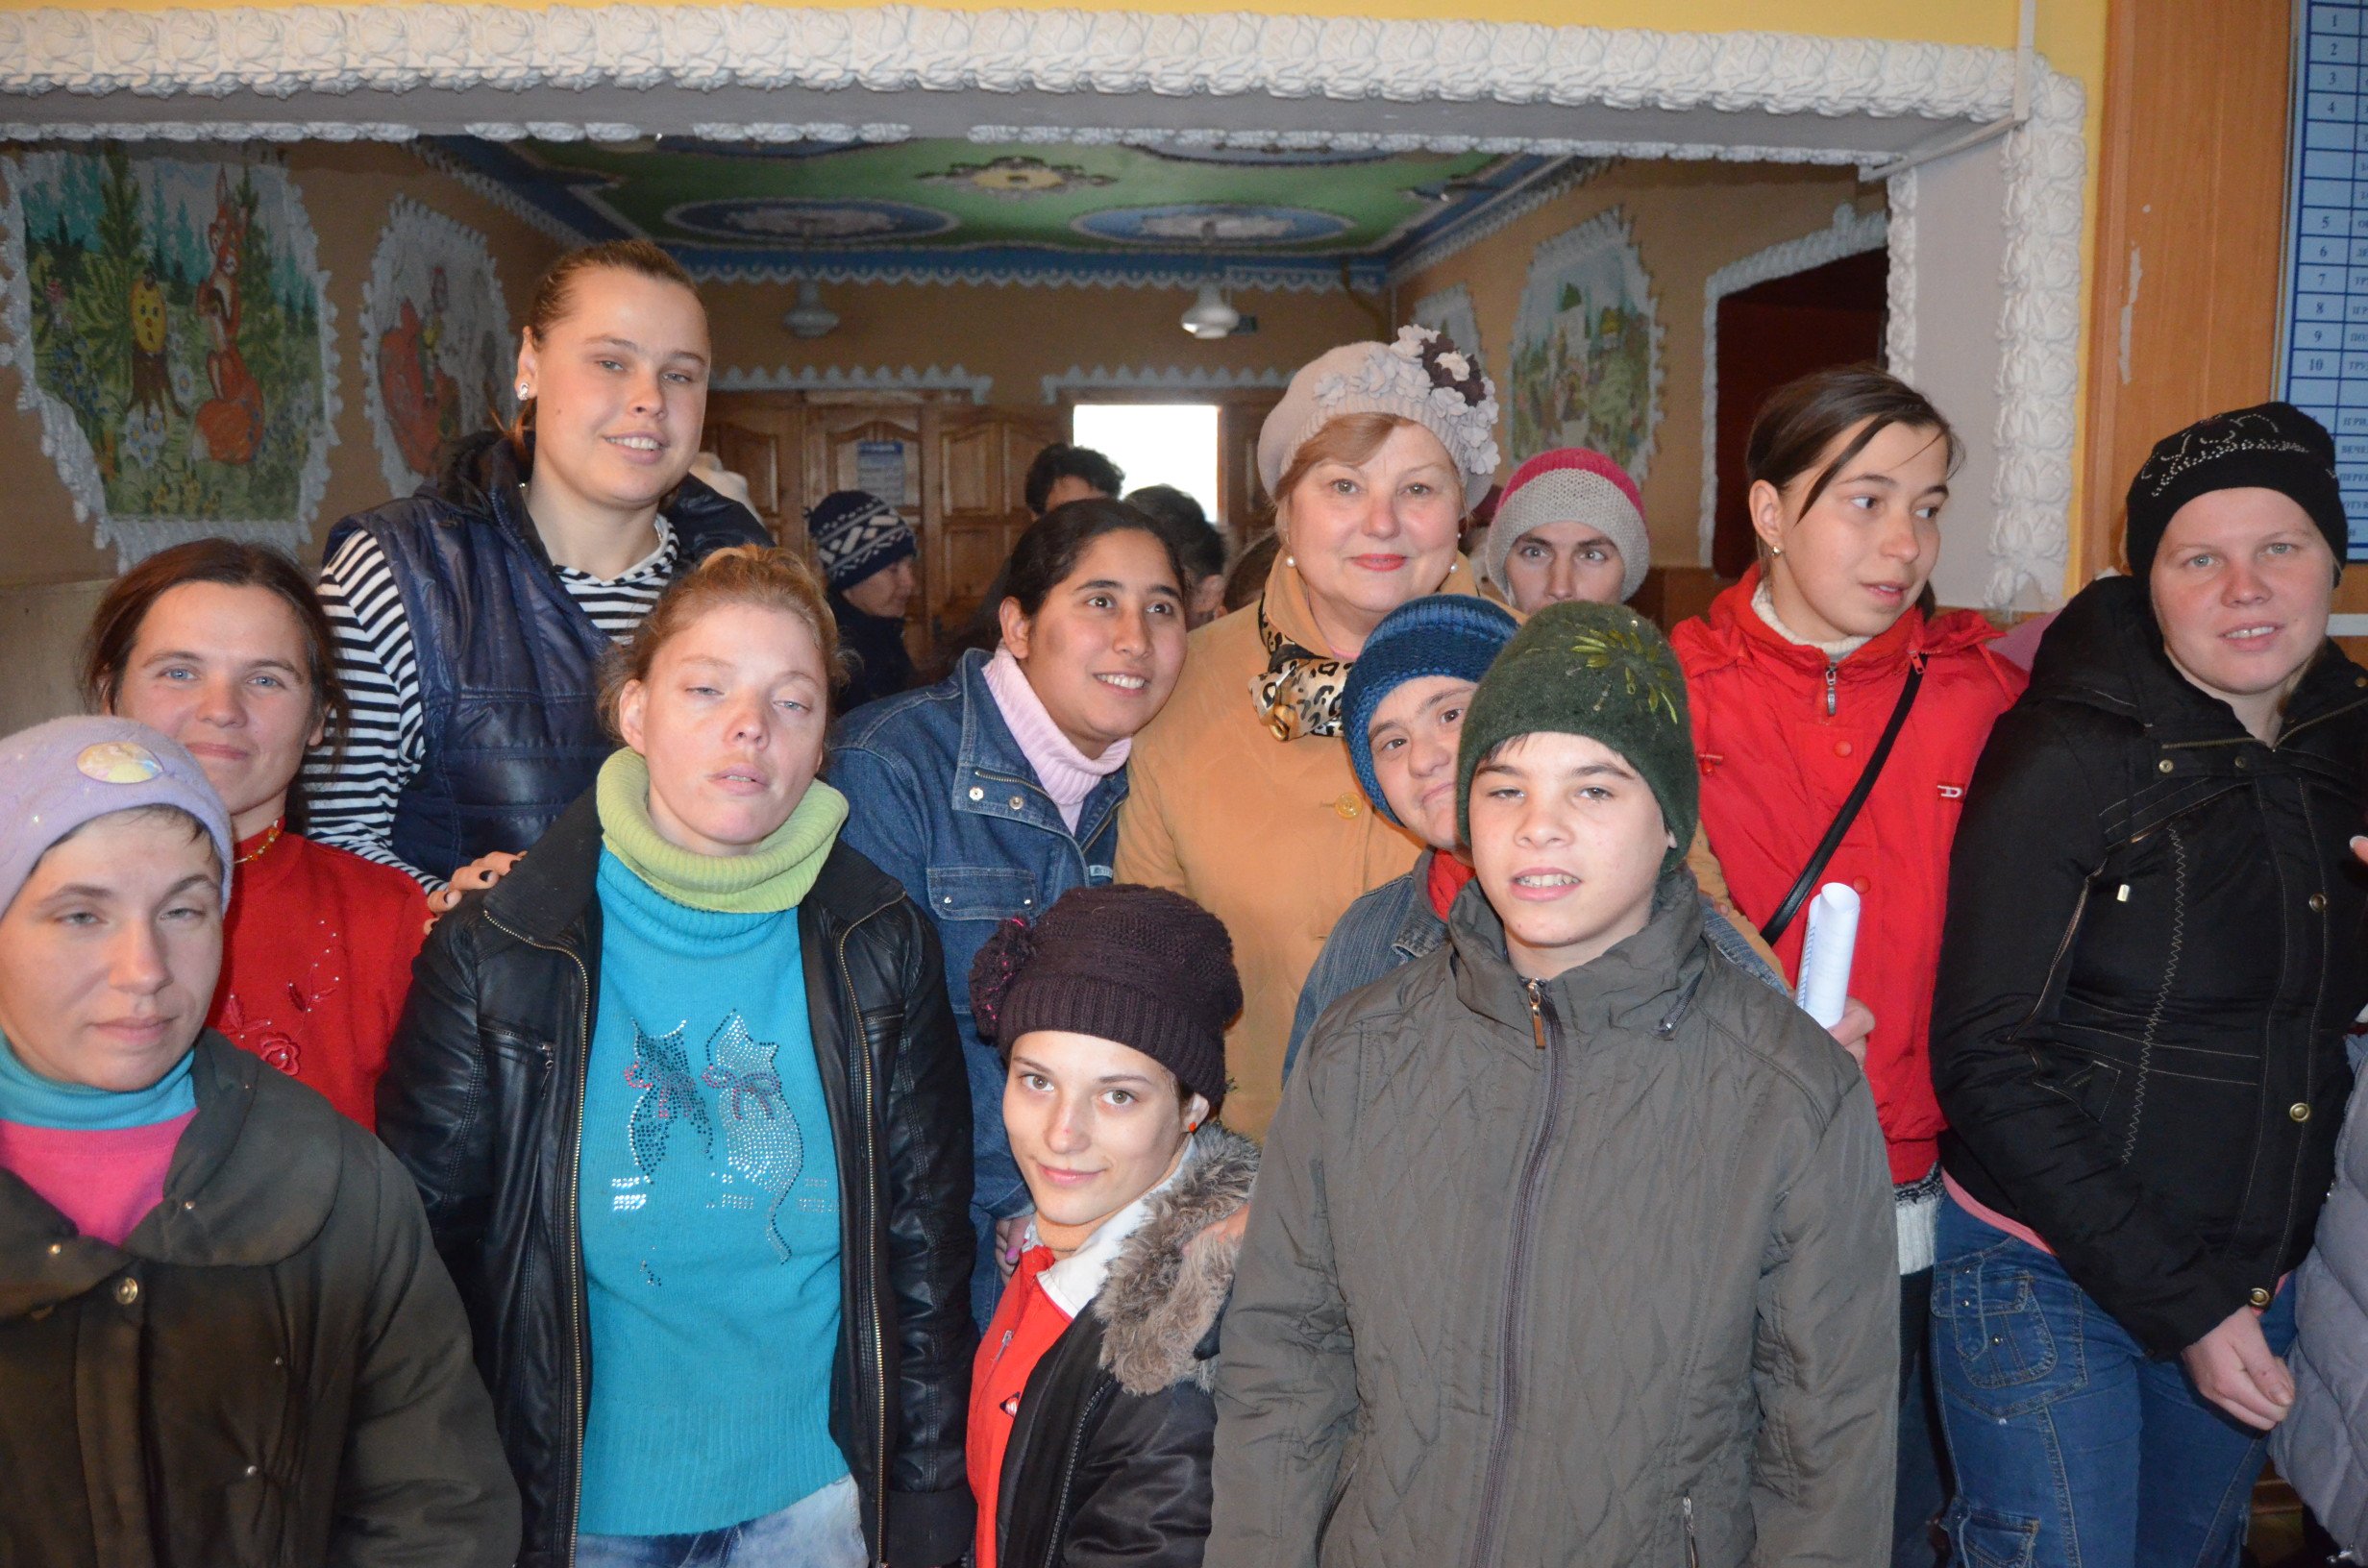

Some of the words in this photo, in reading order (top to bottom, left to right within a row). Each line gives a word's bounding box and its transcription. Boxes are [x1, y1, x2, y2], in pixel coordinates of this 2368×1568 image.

[2332, 13, 2337, 27] 1
[2330, 42, 2337, 56] 2
[2329, 72, 2336, 86] 3
[2328, 101, 2335, 114] 4
[2321, 215, 2330, 230] 5
[2319, 245, 2327, 257] 6
[2318, 273, 2326, 286] 7
[2316, 302, 2324, 314] 8
[2314, 330, 2322, 343] 9
[2308, 357, 2324, 372] 10
